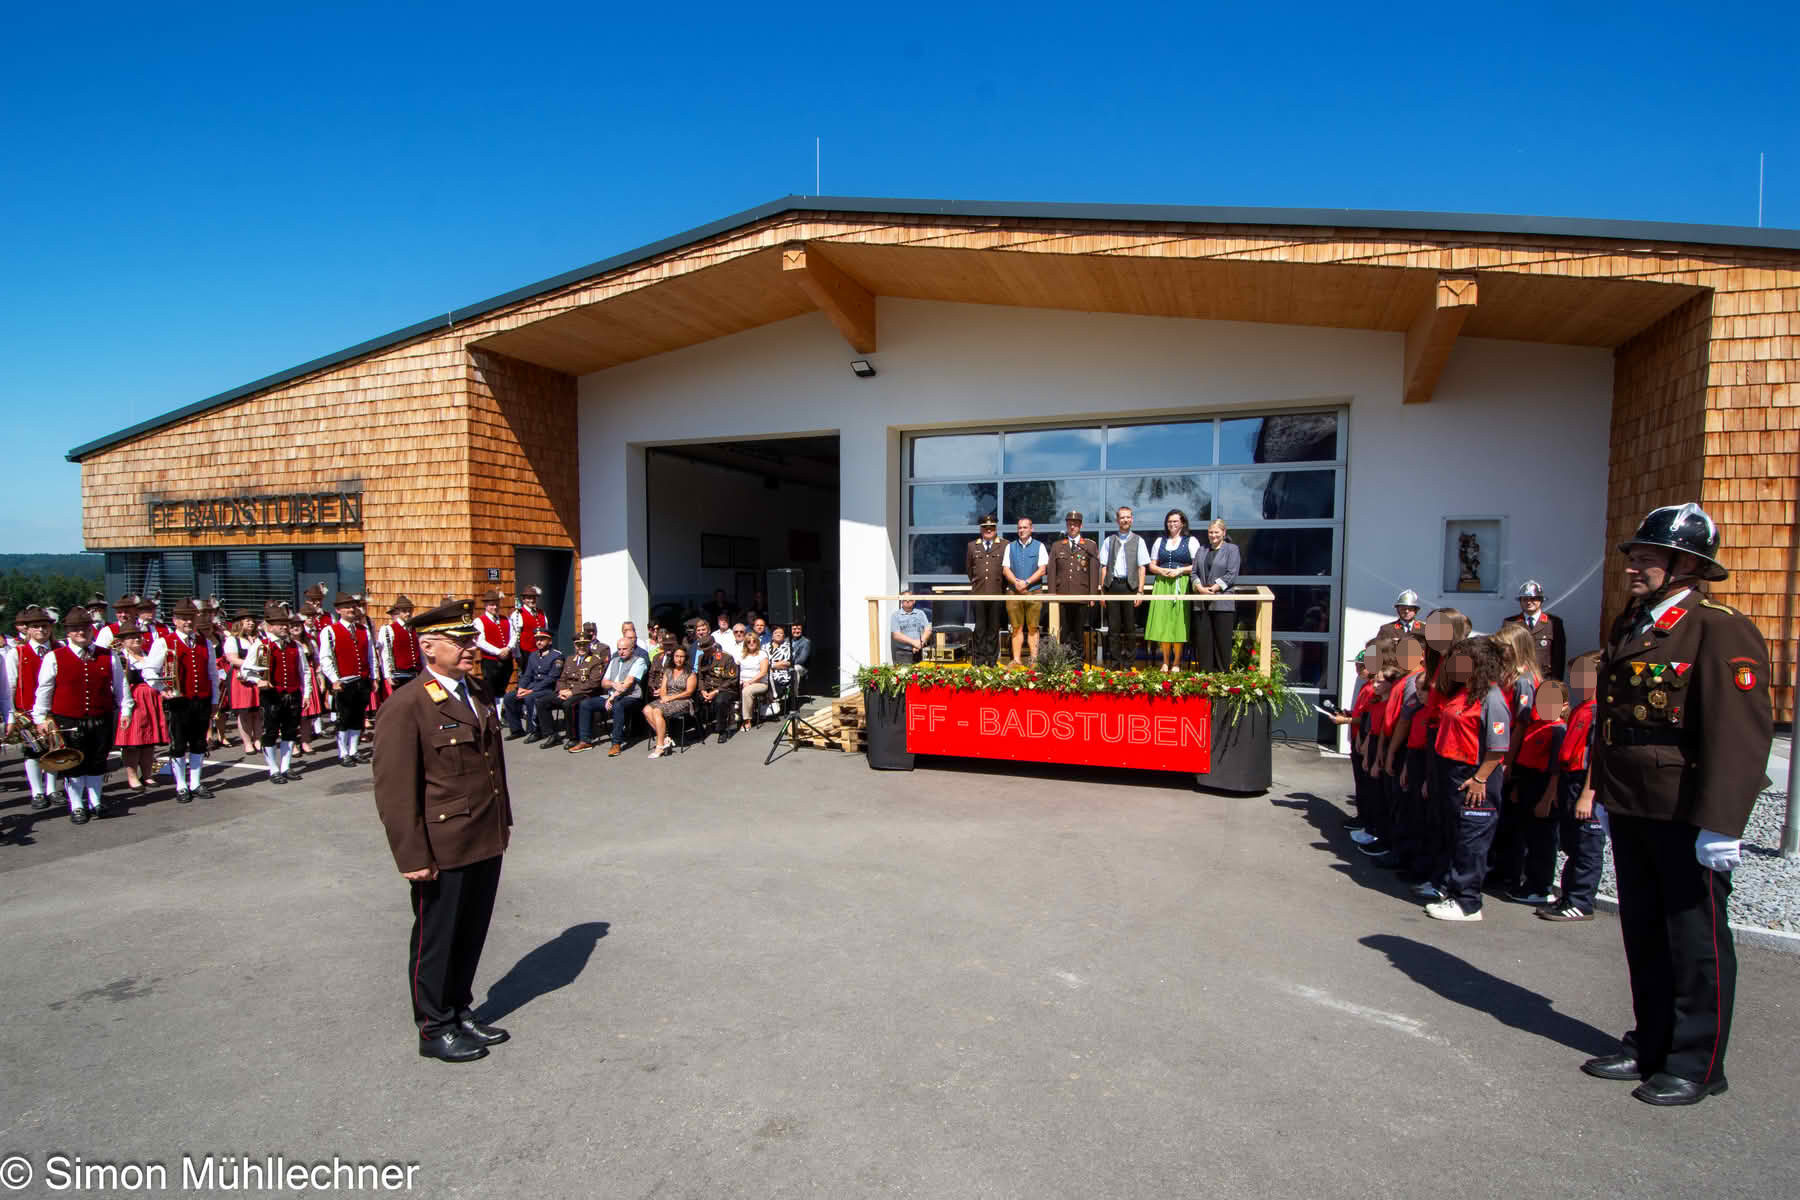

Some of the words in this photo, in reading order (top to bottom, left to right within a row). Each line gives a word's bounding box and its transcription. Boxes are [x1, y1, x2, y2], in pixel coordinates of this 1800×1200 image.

[149, 501, 177, 531] FF
[184, 492, 362, 531] BADSTUBEN
[909, 704, 947, 732] FF
[980, 706, 1207, 748] BADSTUBEN
